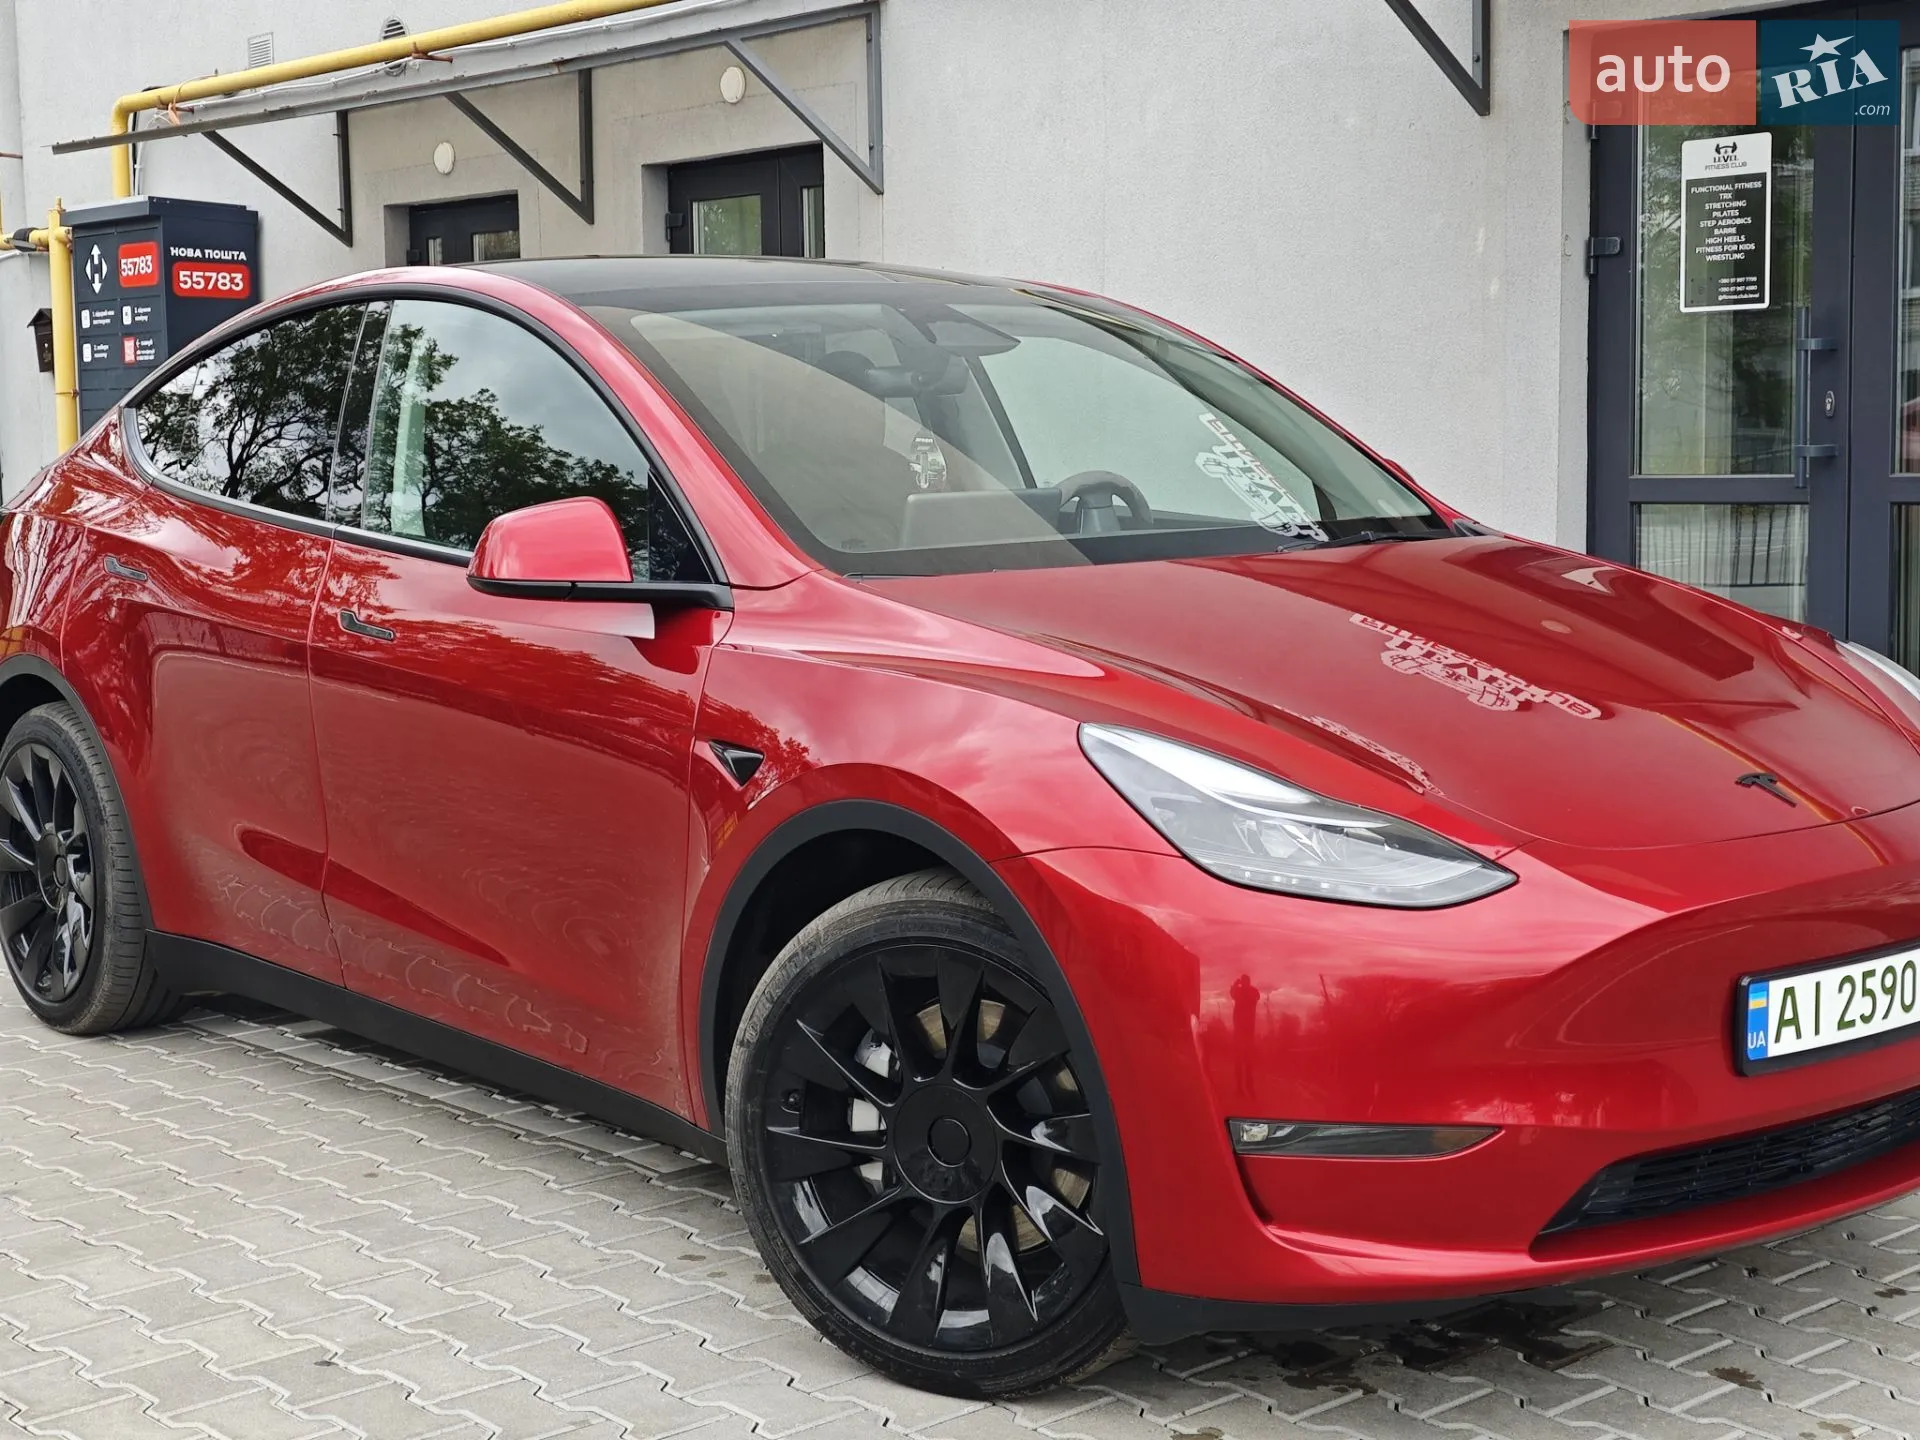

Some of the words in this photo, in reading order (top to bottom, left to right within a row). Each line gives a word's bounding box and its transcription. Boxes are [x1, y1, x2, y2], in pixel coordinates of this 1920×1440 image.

[1714, 155, 1739, 164] LEVEL
[1691, 184, 1734, 195] FUNCTIONAL
[1735, 181, 1763, 191] FITNESS
[1705, 201, 1747, 210] STRETCHING
[1713, 210, 1740, 218] PILATES
[1700, 220, 1717, 228] STEP
[1718, 218, 1752, 227] AEROBICS
[1714, 227, 1737, 235] BARRE
[1706, 237, 1723, 245] HIGH
[170, 246, 202, 259] НОВА
[204, 248, 247, 261] ПОШТА
[1696, 246, 1724, 254] FITNESS
[1739, 243, 1756, 251] KIDS
[1706, 253, 1746, 262] WRESTLING
[120, 255, 153, 277] 55783
[178, 270, 244, 292] 55783
[1774, 981, 1821, 1044] AI
[1837, 959, 1917, 1031] 2590
[1747, 1030, 1766, 1049] UA
